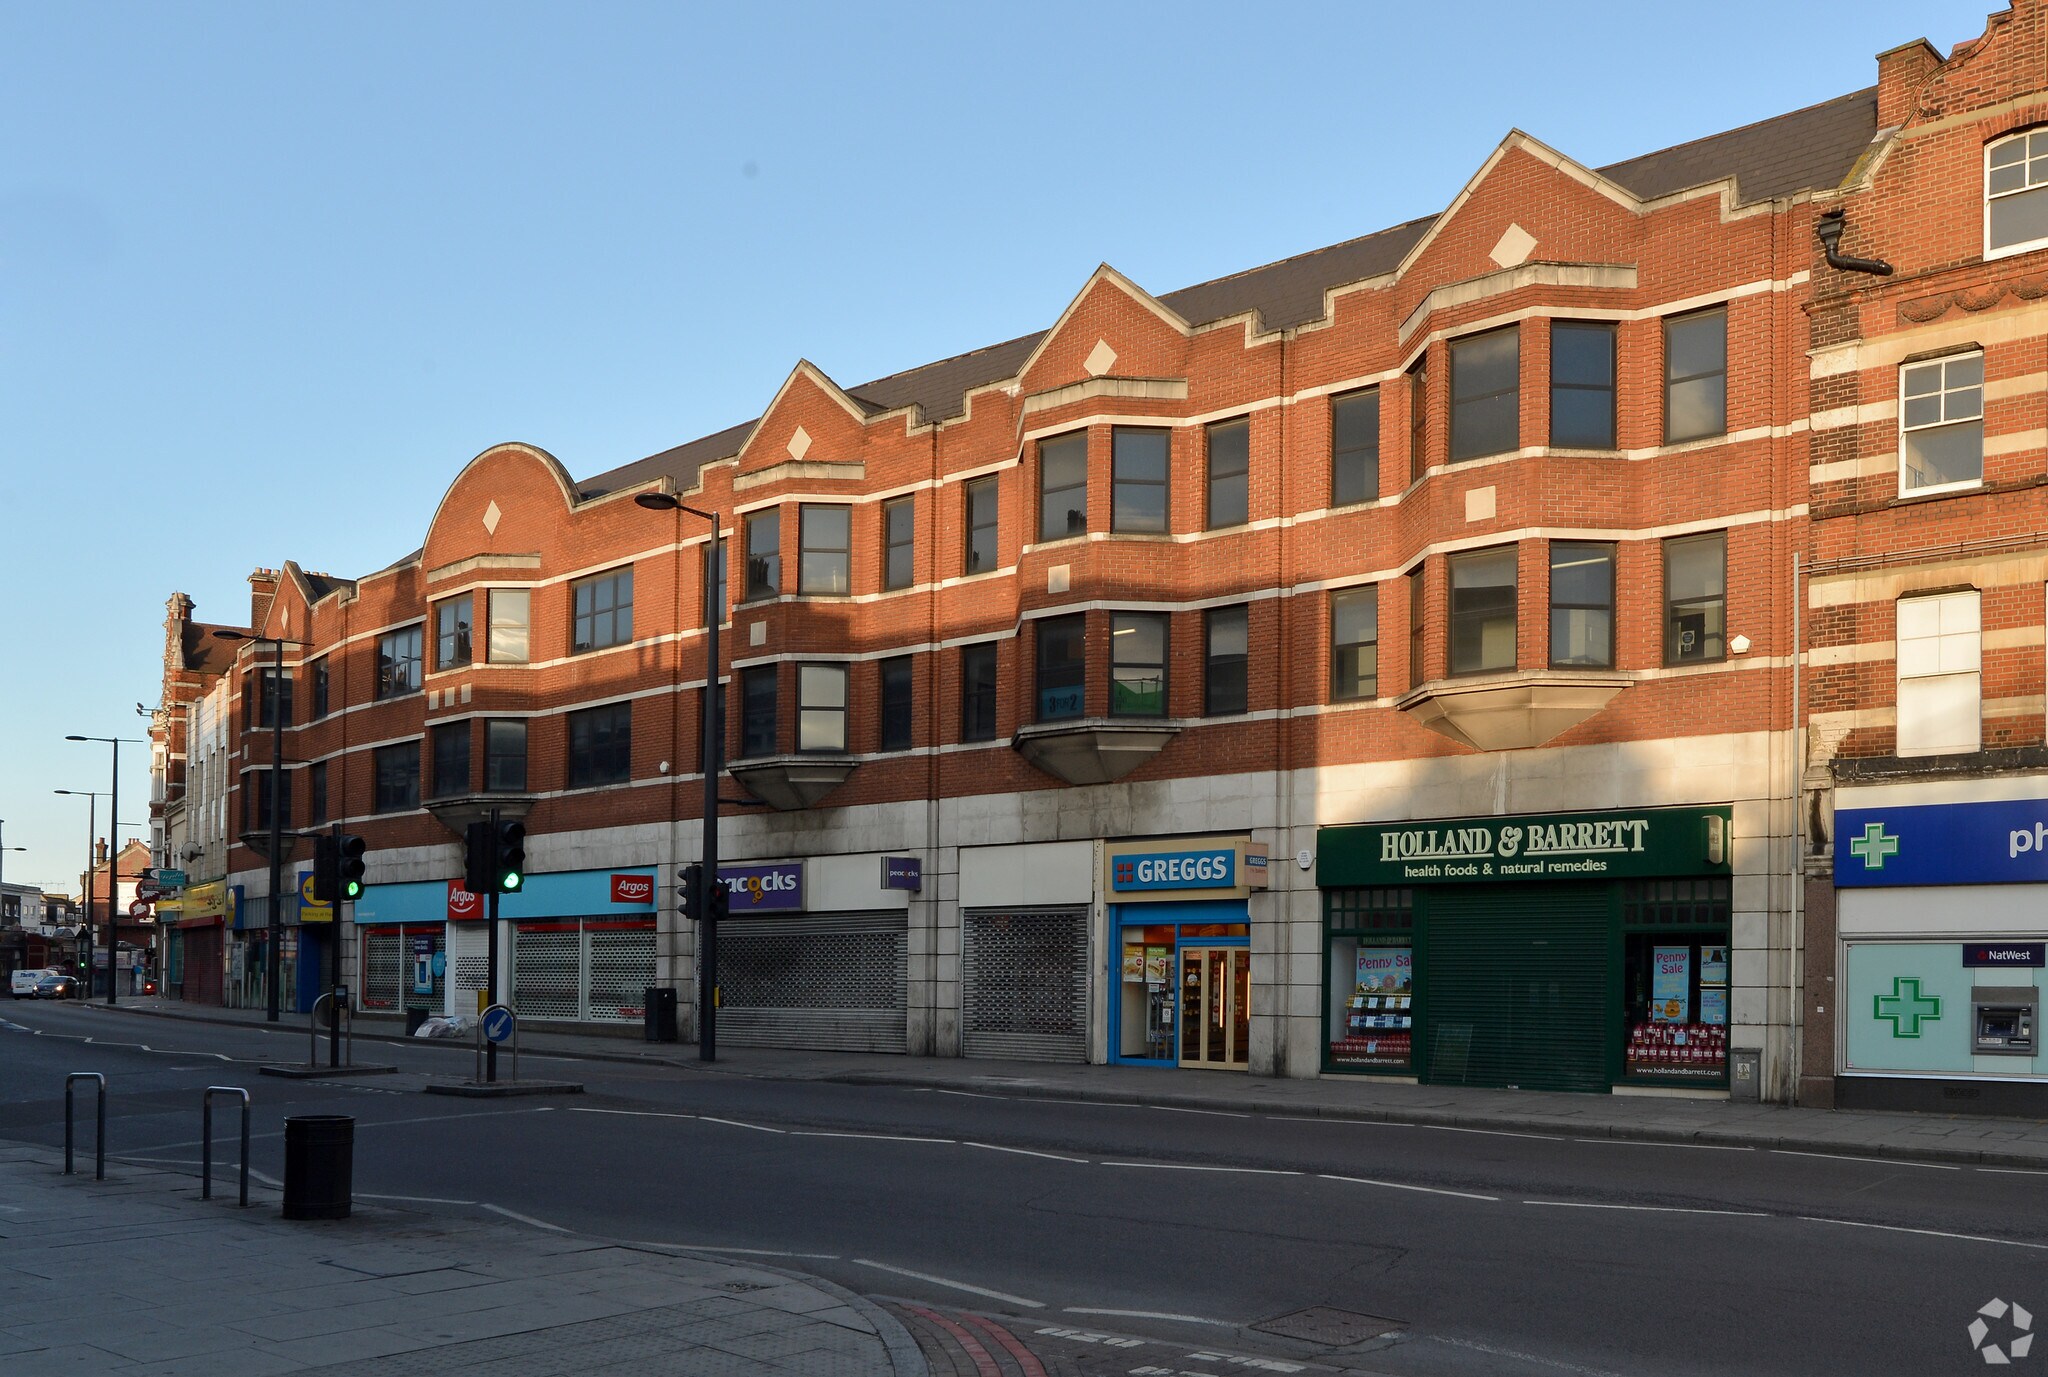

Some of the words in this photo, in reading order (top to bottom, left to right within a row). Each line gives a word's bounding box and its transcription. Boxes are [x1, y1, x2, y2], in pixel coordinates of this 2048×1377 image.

[1049, 695, 1056, 713] 3
[1070, 694, 1078, 711] 2
[1380, 828, 1492, 862] HOLLAND
[1497, 826, 1523, 858] &
[1527, 819, 1649, 853] BARRETT
[1249, 857, 1267, 865] GREGGS
[1405, 864, 1441, 877] health
[1444, 863, 1478, 876] foods
[1482, 862, 1493, 875] &
[1500, 860, 1544, 874] natural
[1548, 858, 1607, 873] remedies
[889, 870, 919, 878] peacocks
[1137, 856, 1227, 883] GREGGS
[618, 880, 649, 895] Argos
[717, 871, 797, 893] acocks
[449, 887, 475, 907] Argos
[1656, 953, 1687, 963] Penny
[1988, 949, 2031, 961] NatWest
[1358, 957, 1392, 970] Penny
[1661, 963, 1684, 974] Sale
[1635, 1068, 1721, 1076] www.hollandandbarrett.com
